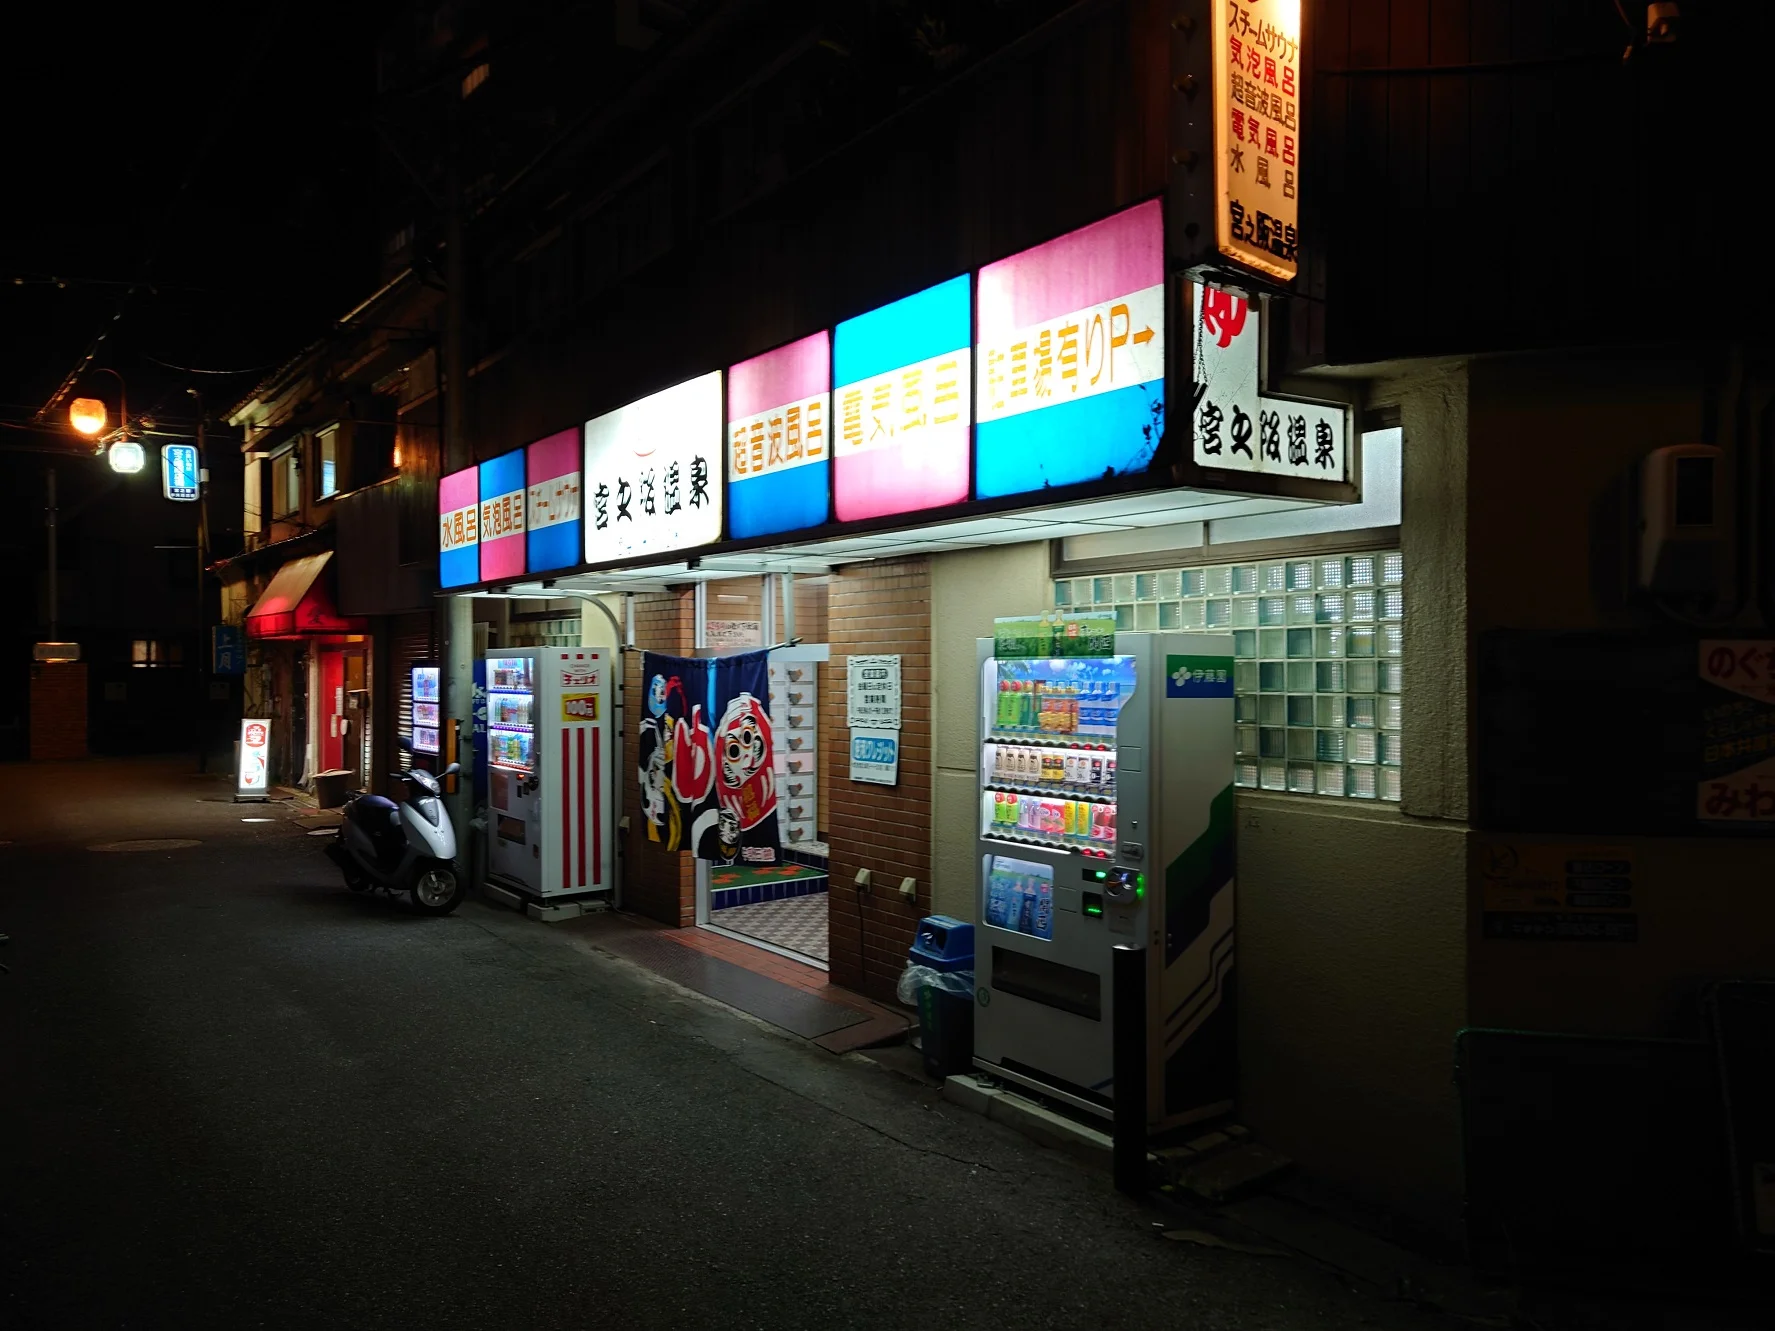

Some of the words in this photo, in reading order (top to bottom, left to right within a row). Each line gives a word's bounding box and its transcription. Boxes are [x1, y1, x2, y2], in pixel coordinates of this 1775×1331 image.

[1228, 1, 1299, 63] スチームサウナ
[1229, 37, 1296, 97] 気泡風呂
[1230, 73, 1296, 132] 超音波風呂
[1231, 108, 1296, 167] 電気風呂
[1229, 199, 1298, 264] 宮之阪温泉
[1203, 285, 1248, 349] ゆ
[442, 508, 477, 548] 水風呂
[482, 494, 523, 539] 気泡風呂
[1192, 669, 1227, 683] 伊藤園
